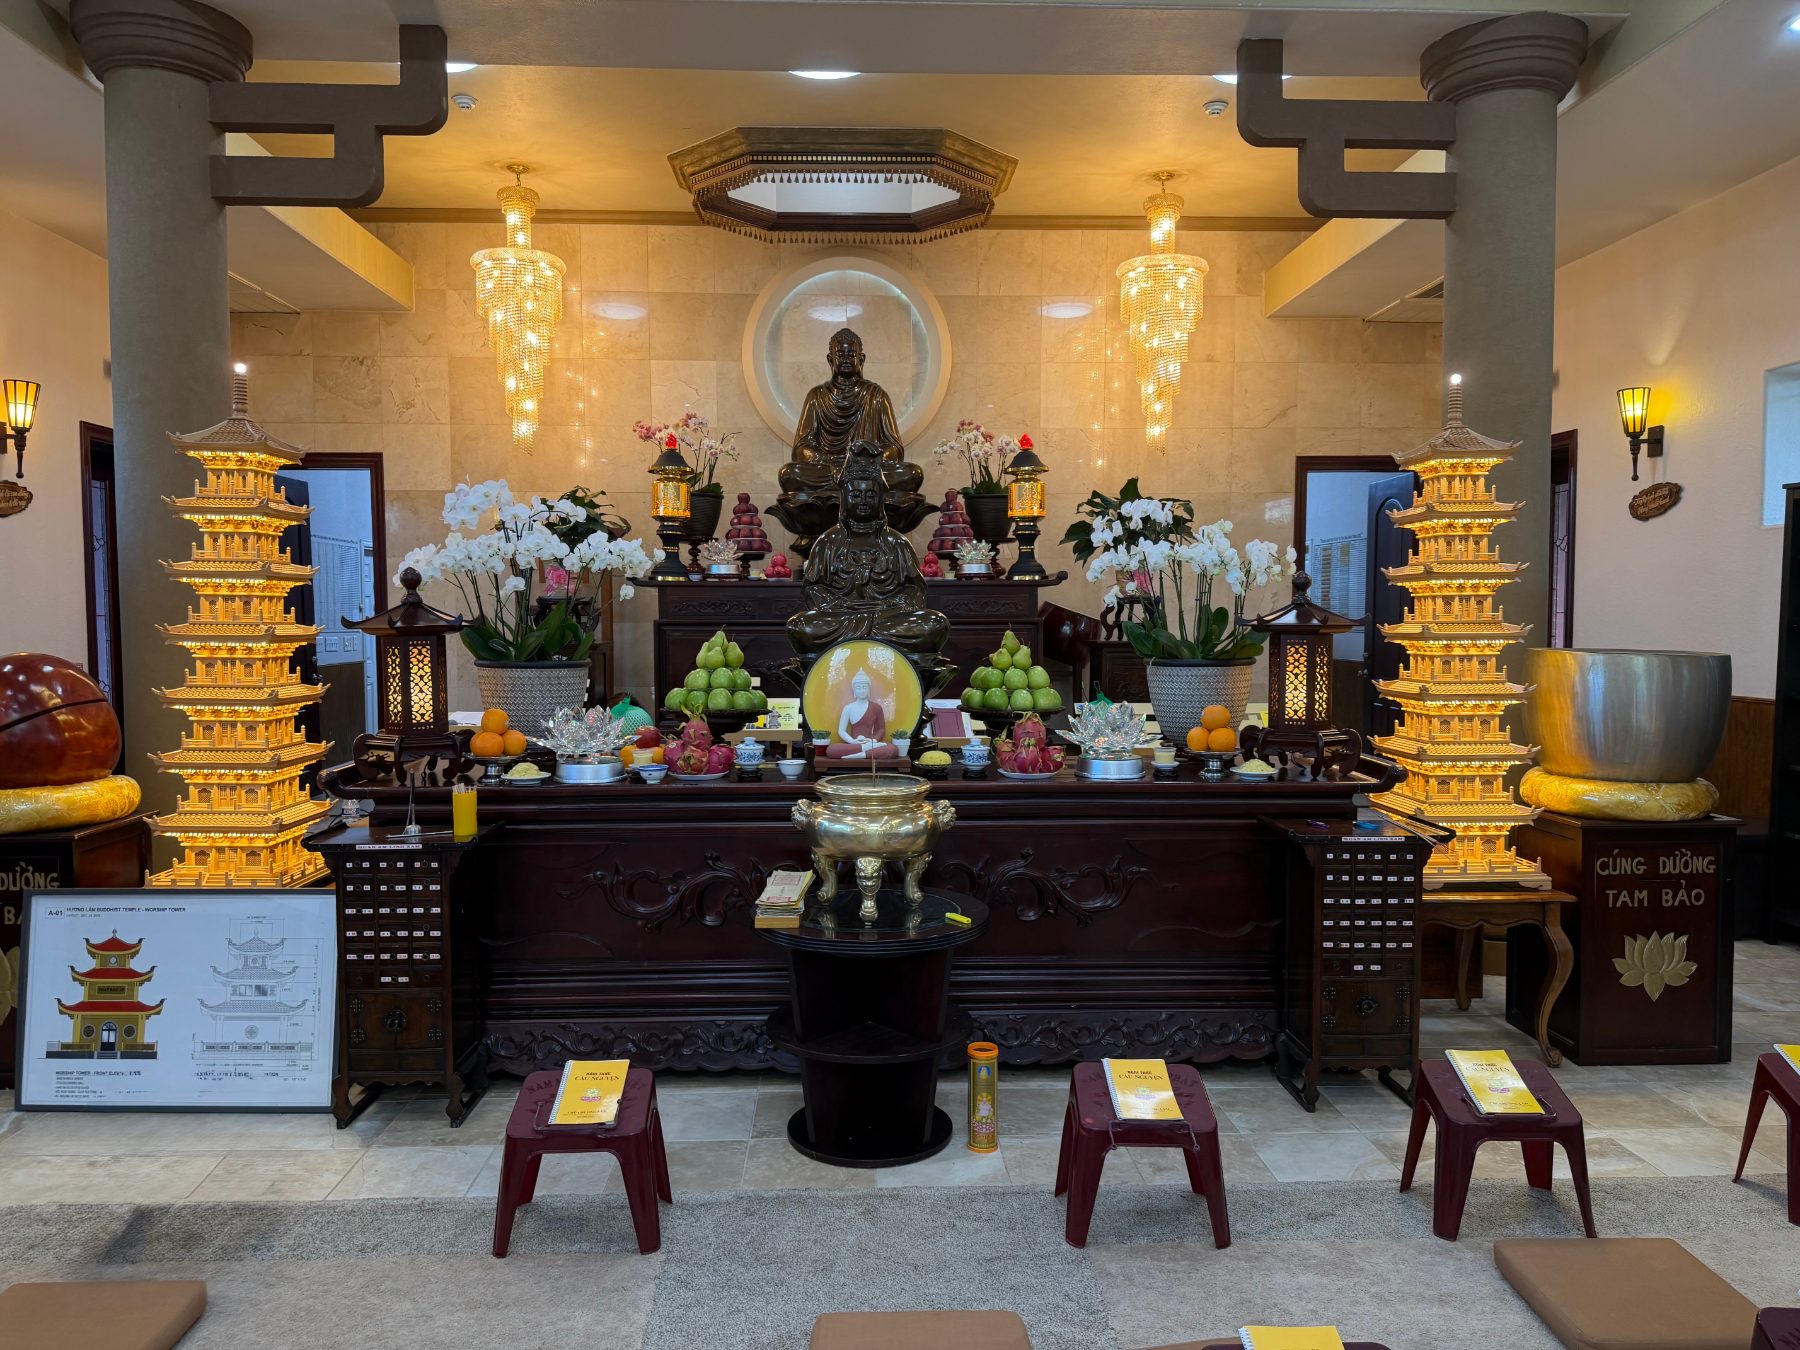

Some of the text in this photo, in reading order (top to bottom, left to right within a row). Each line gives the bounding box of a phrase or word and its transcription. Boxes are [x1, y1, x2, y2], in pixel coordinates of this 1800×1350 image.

[1596, 849, 1648, 875] CÚNG
[1605, 880, 1705, 908] TAM BẢO
